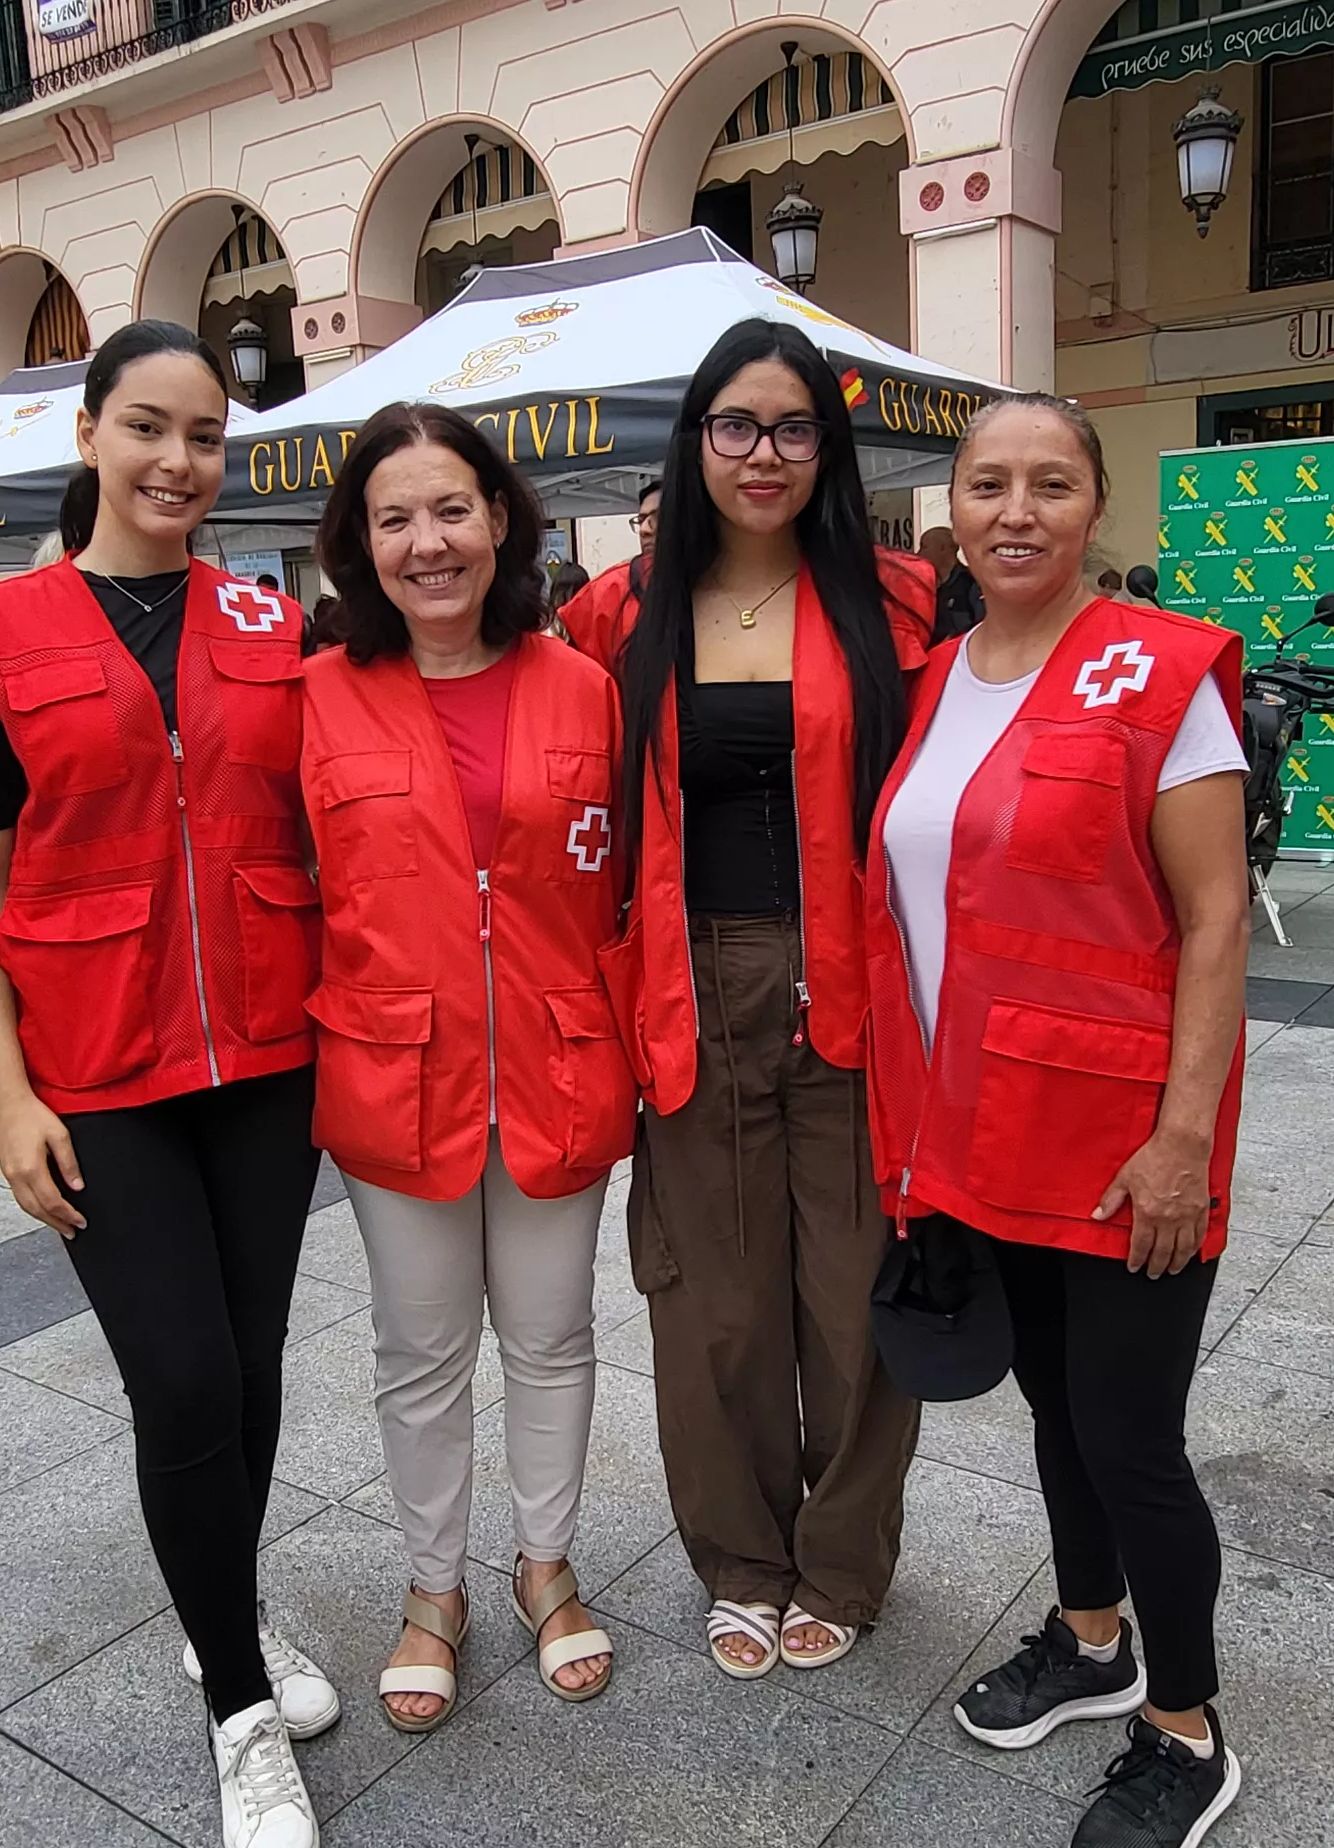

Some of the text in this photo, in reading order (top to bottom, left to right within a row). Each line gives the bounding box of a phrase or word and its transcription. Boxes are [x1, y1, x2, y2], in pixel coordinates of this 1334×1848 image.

[41, 10, 53, 28] SE
[1102, 45, 1170, 89] pruebe
[1179, 38, 1213, 64] sus
